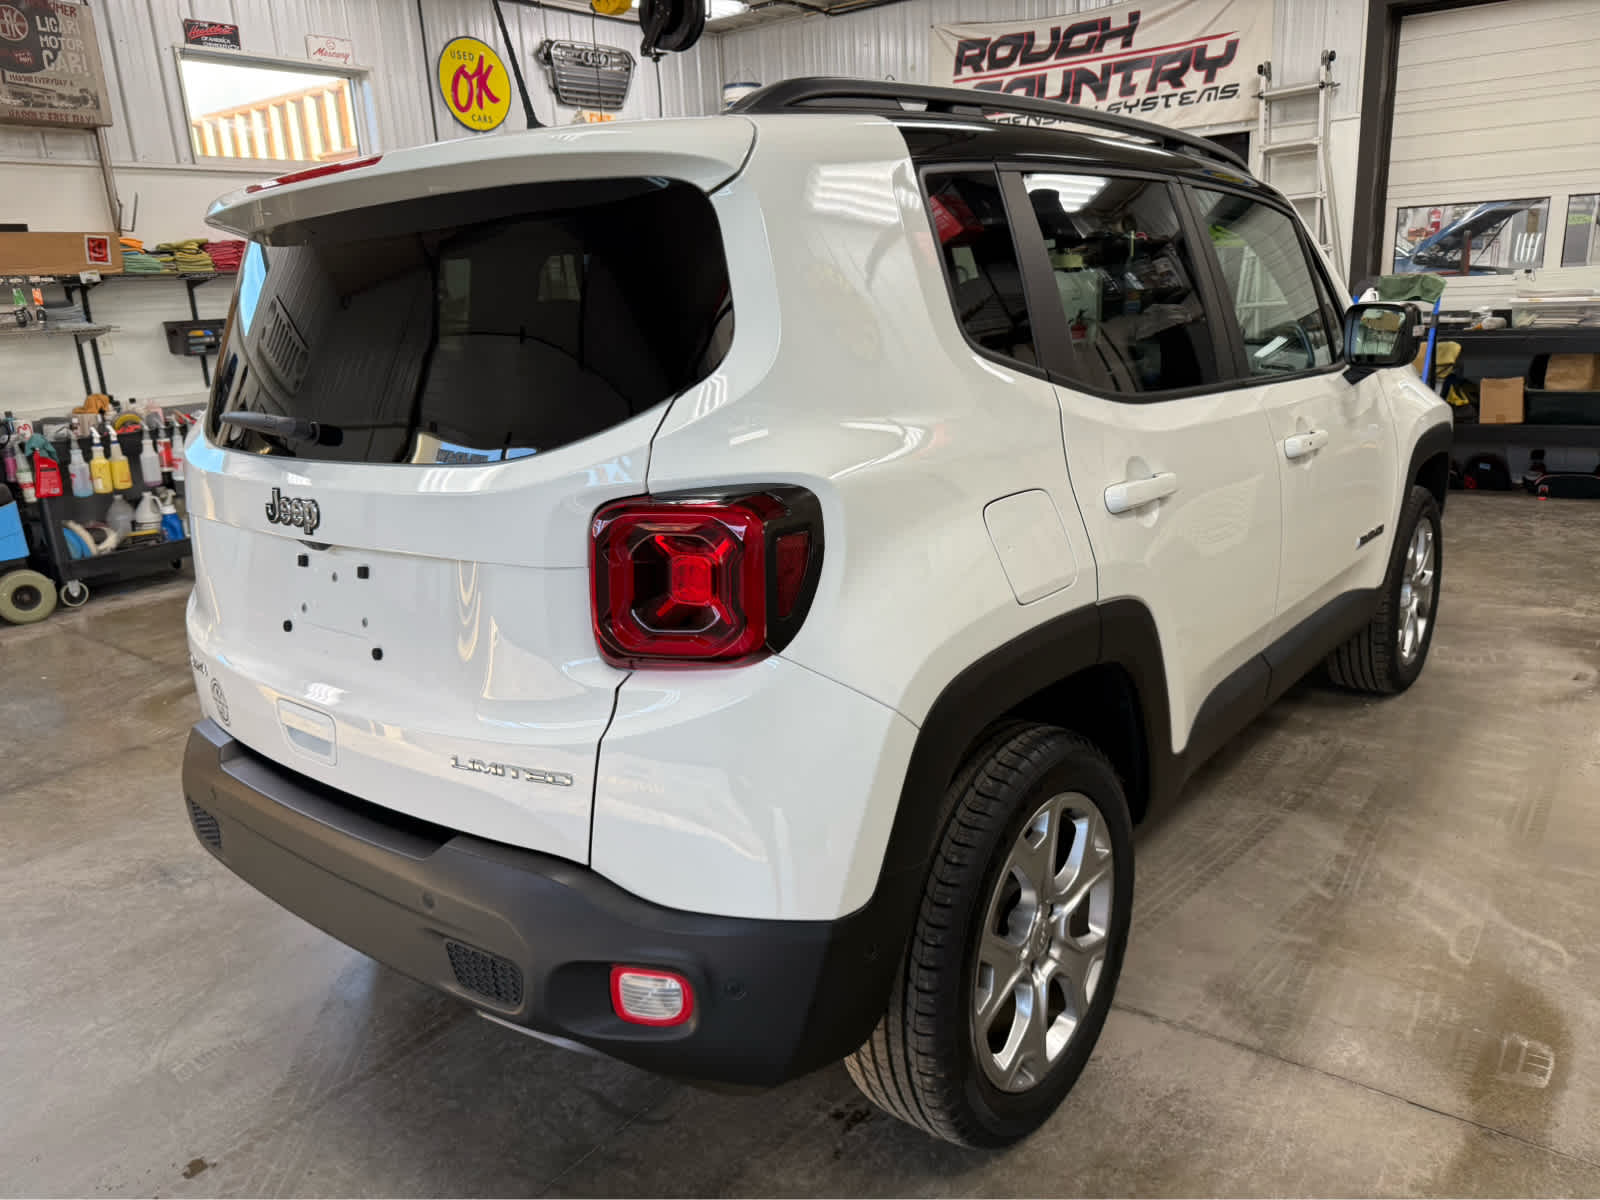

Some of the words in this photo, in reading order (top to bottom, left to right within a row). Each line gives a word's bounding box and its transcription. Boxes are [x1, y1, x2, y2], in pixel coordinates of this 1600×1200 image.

[39, 35, 84, 52] MOTOR
[450, 51, 475, 62] USED
[953, 10, 1141, 76] ROUGH
[451, 53, 501, 113] OK
[1105, 82, 1241, 114] SYSTEMS
[471, 113, 494, 125] CARS
[264, 487, 321, 535] Jeep
[451, 754, 574, 786] LIMITED
